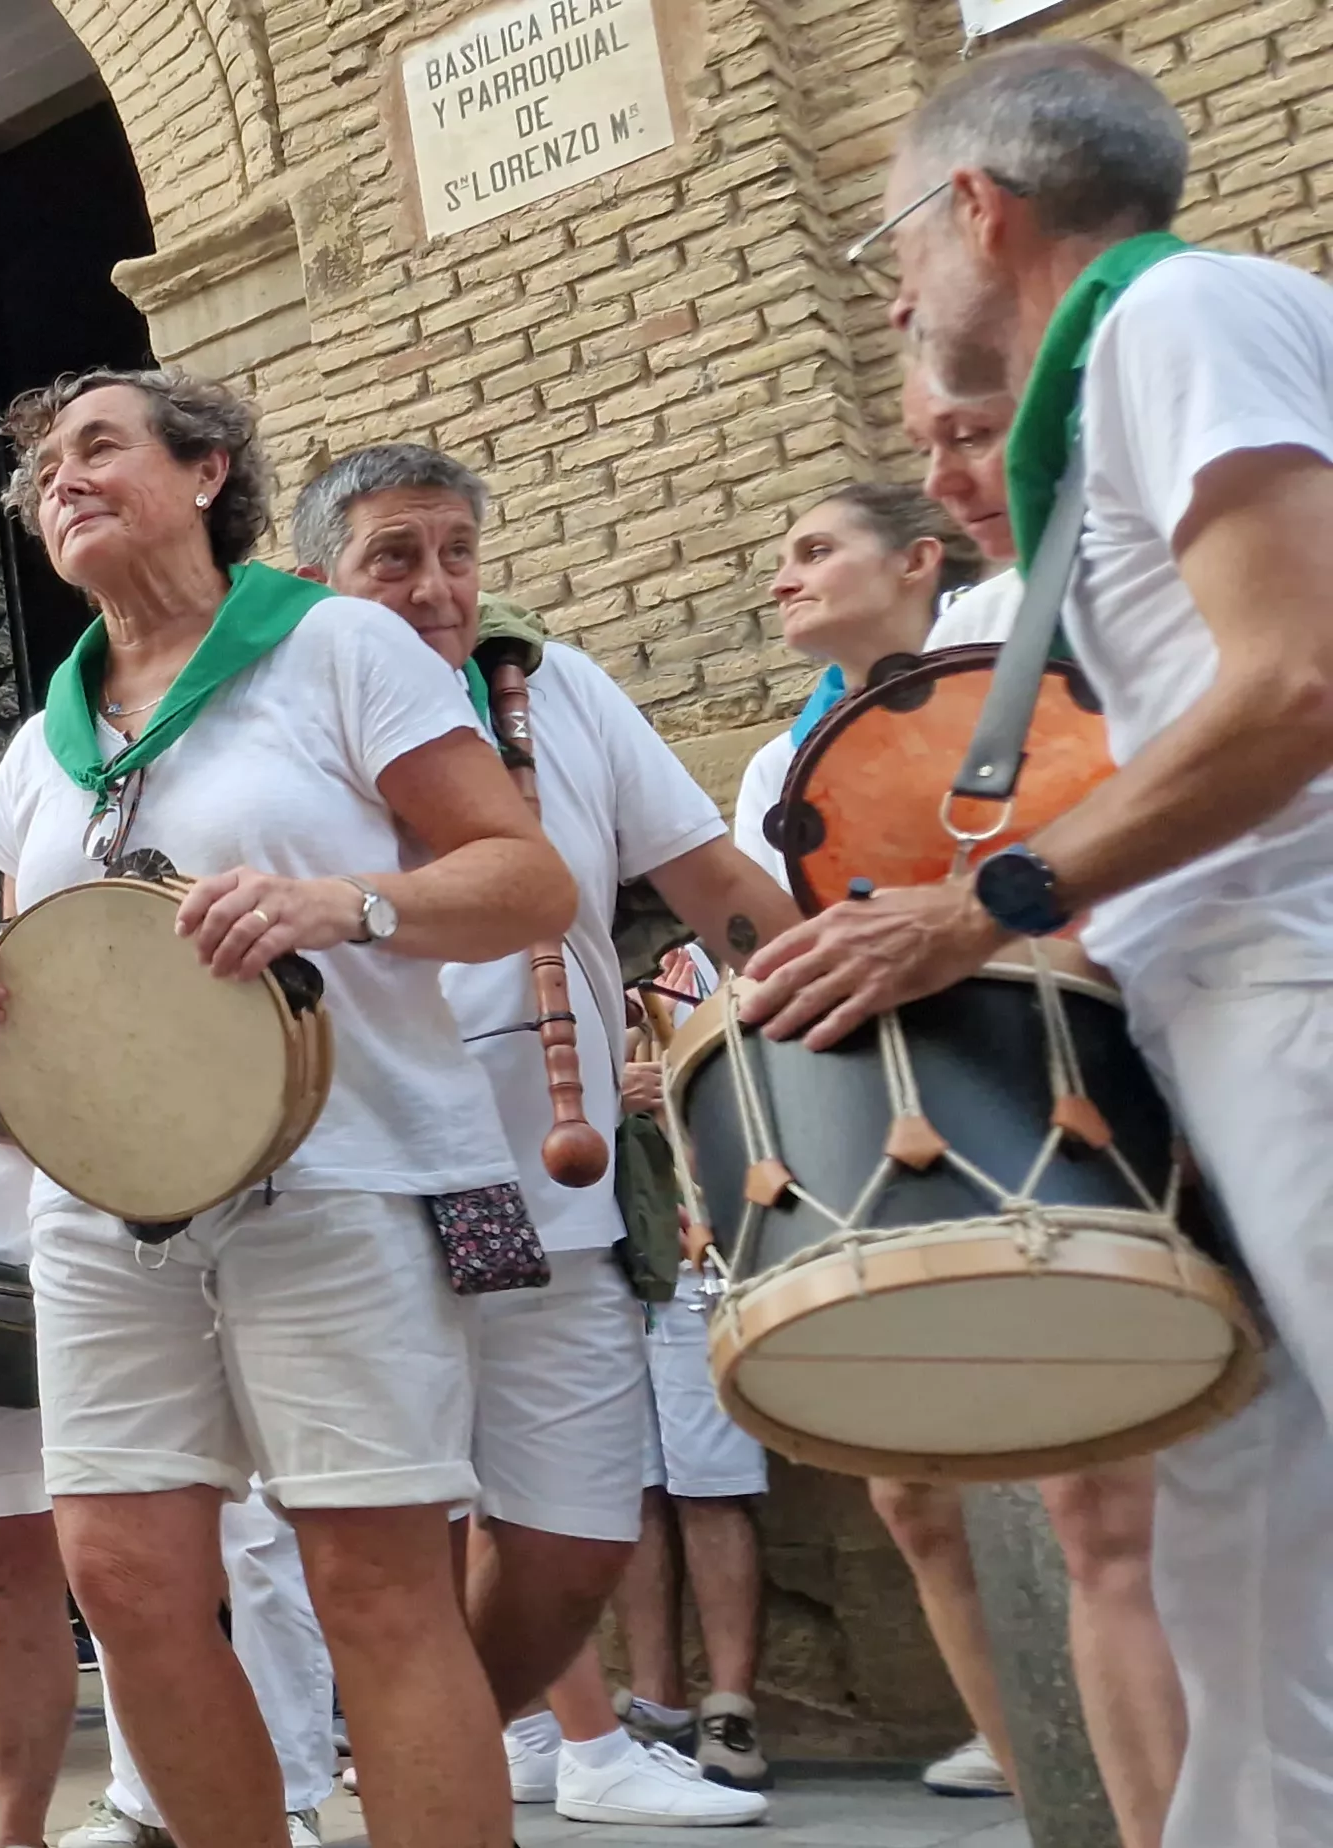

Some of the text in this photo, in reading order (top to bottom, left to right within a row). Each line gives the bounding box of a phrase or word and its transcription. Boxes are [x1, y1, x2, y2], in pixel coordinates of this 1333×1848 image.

[426, 13, 543, 90] BASÍLICA
[432, 22, 629, 129] Y PARROQUIAL
[515, 95, 553, 138] DE
[471, 122, 600, 201] LORENZO
